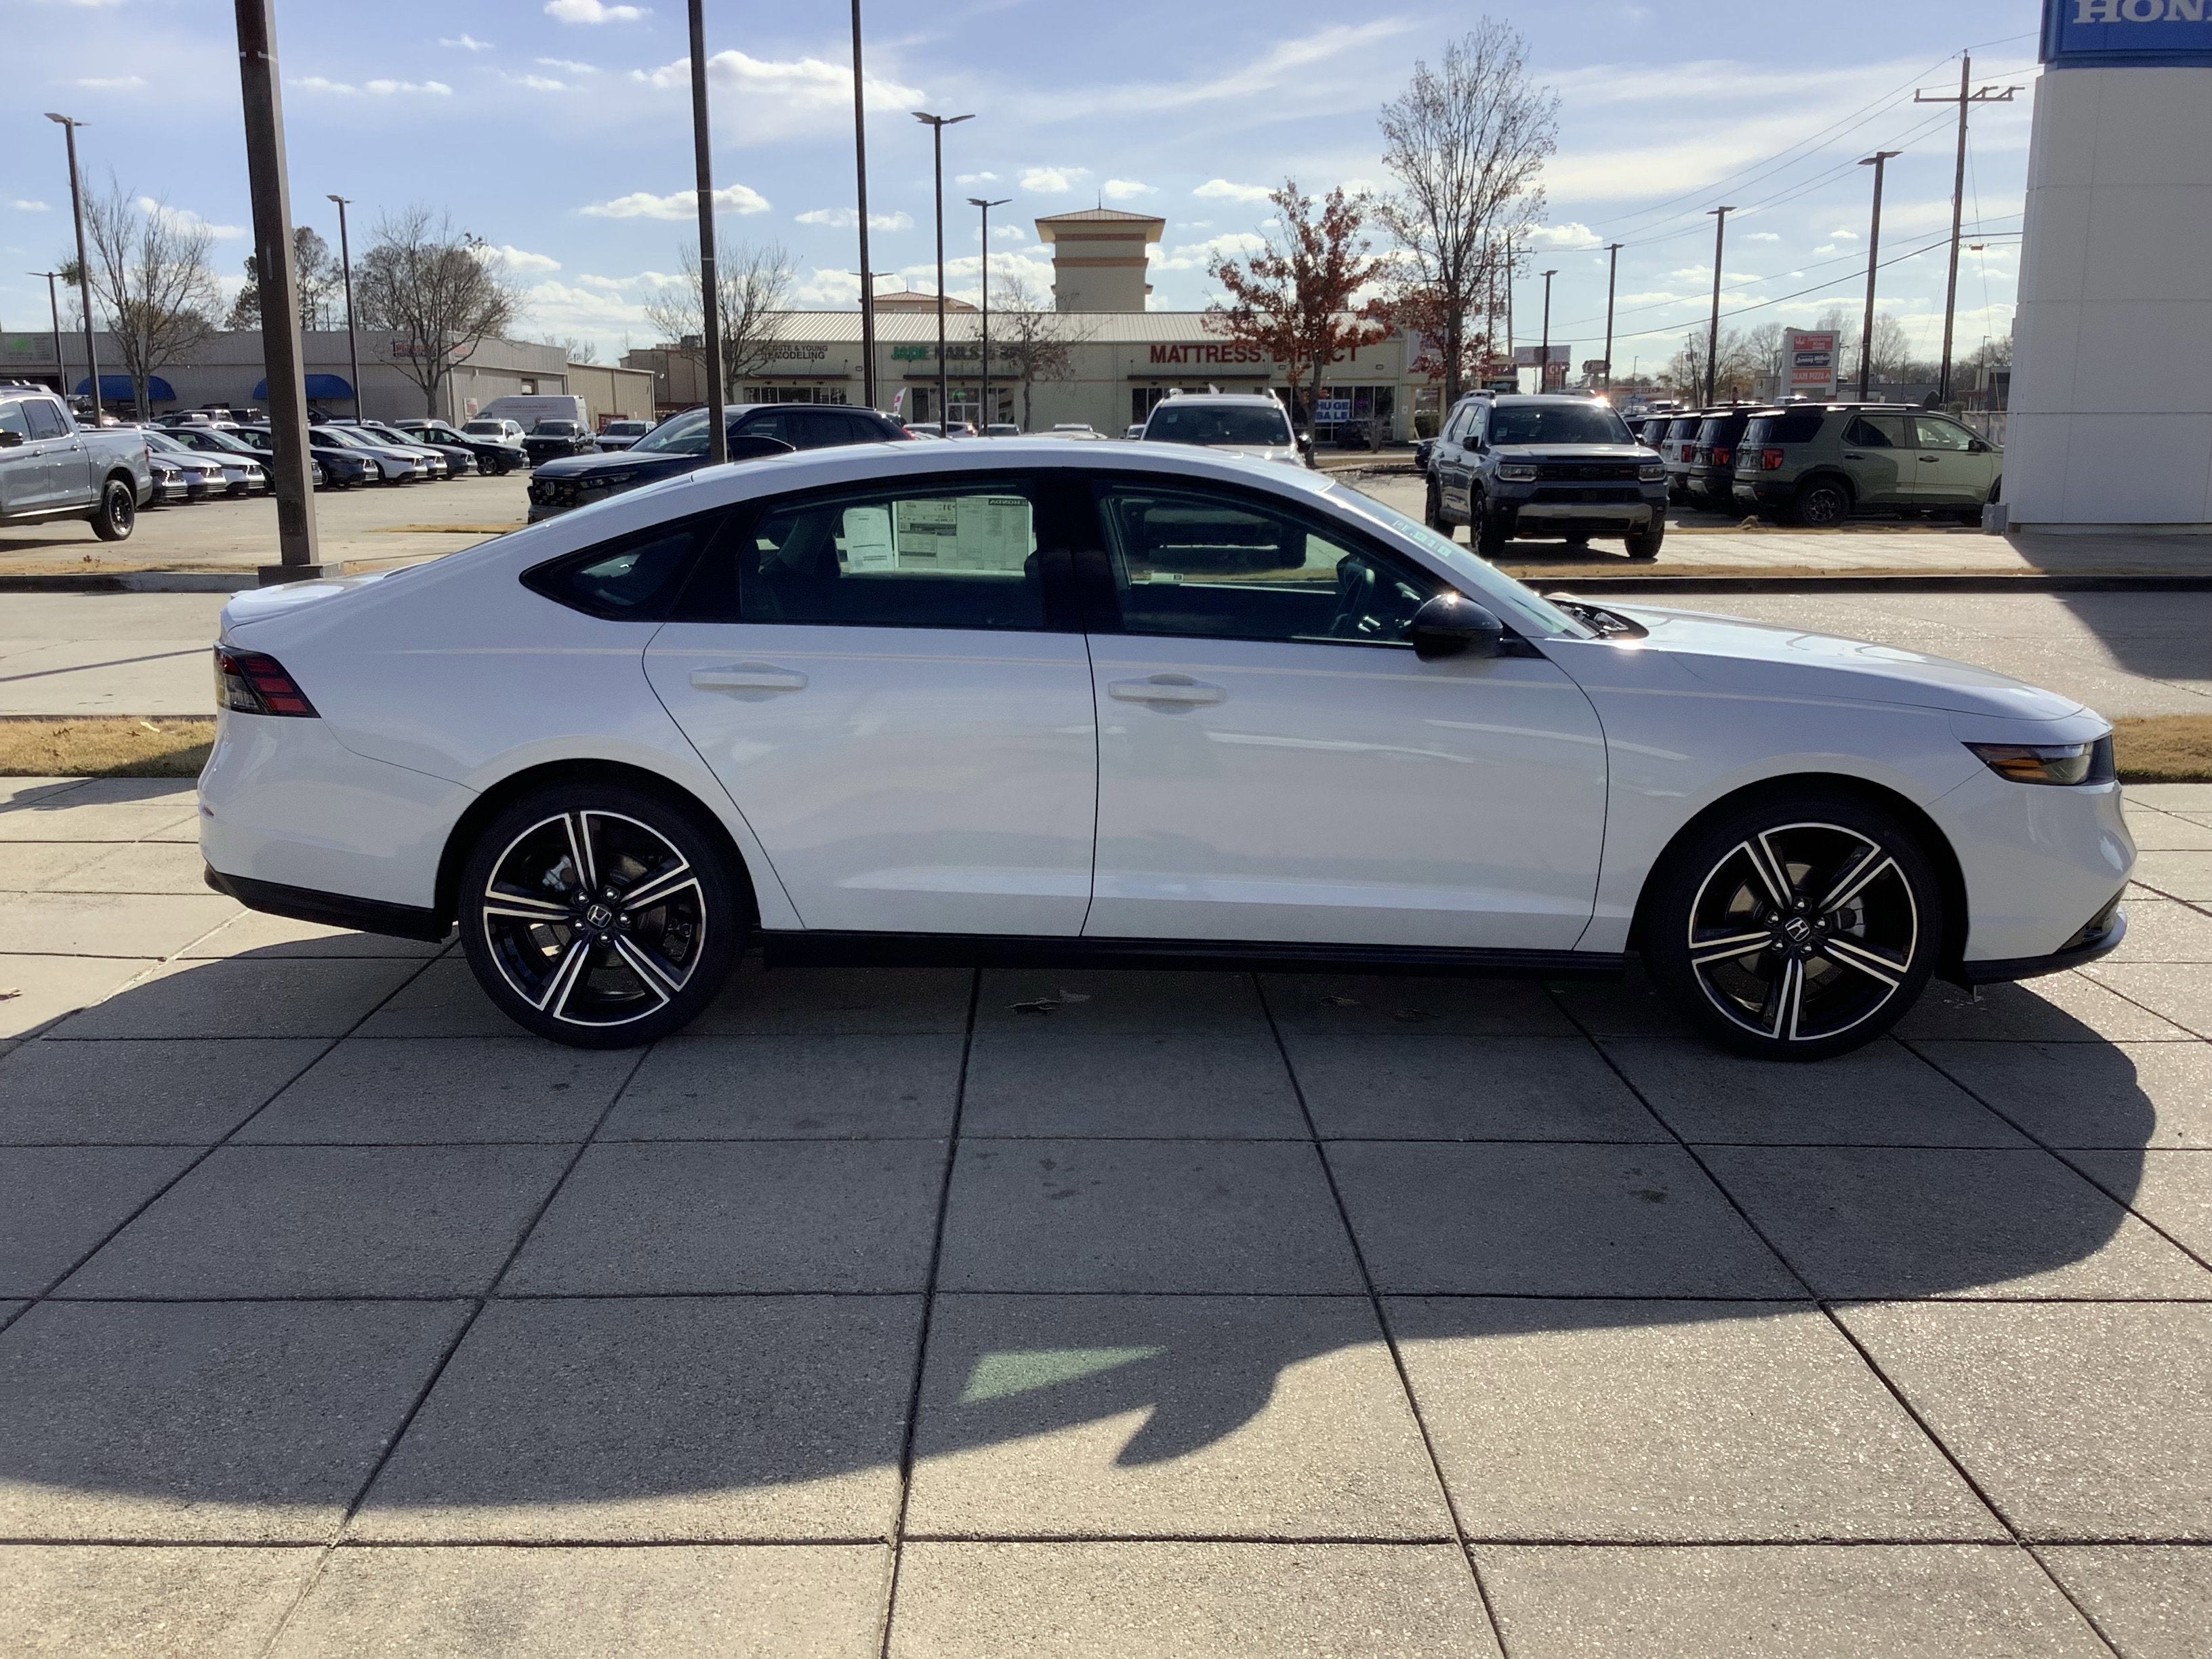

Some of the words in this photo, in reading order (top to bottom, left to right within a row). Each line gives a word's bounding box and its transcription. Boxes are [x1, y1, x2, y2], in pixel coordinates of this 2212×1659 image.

[2072, 0, 2212, 23] HON
[934, 346, 980, 361] NAILS
[1150, 345, 1263, 363] MATTRESS
[1317, 402, 1349, 410] HUGE
[1316, 411, 1348, 419] SALE
